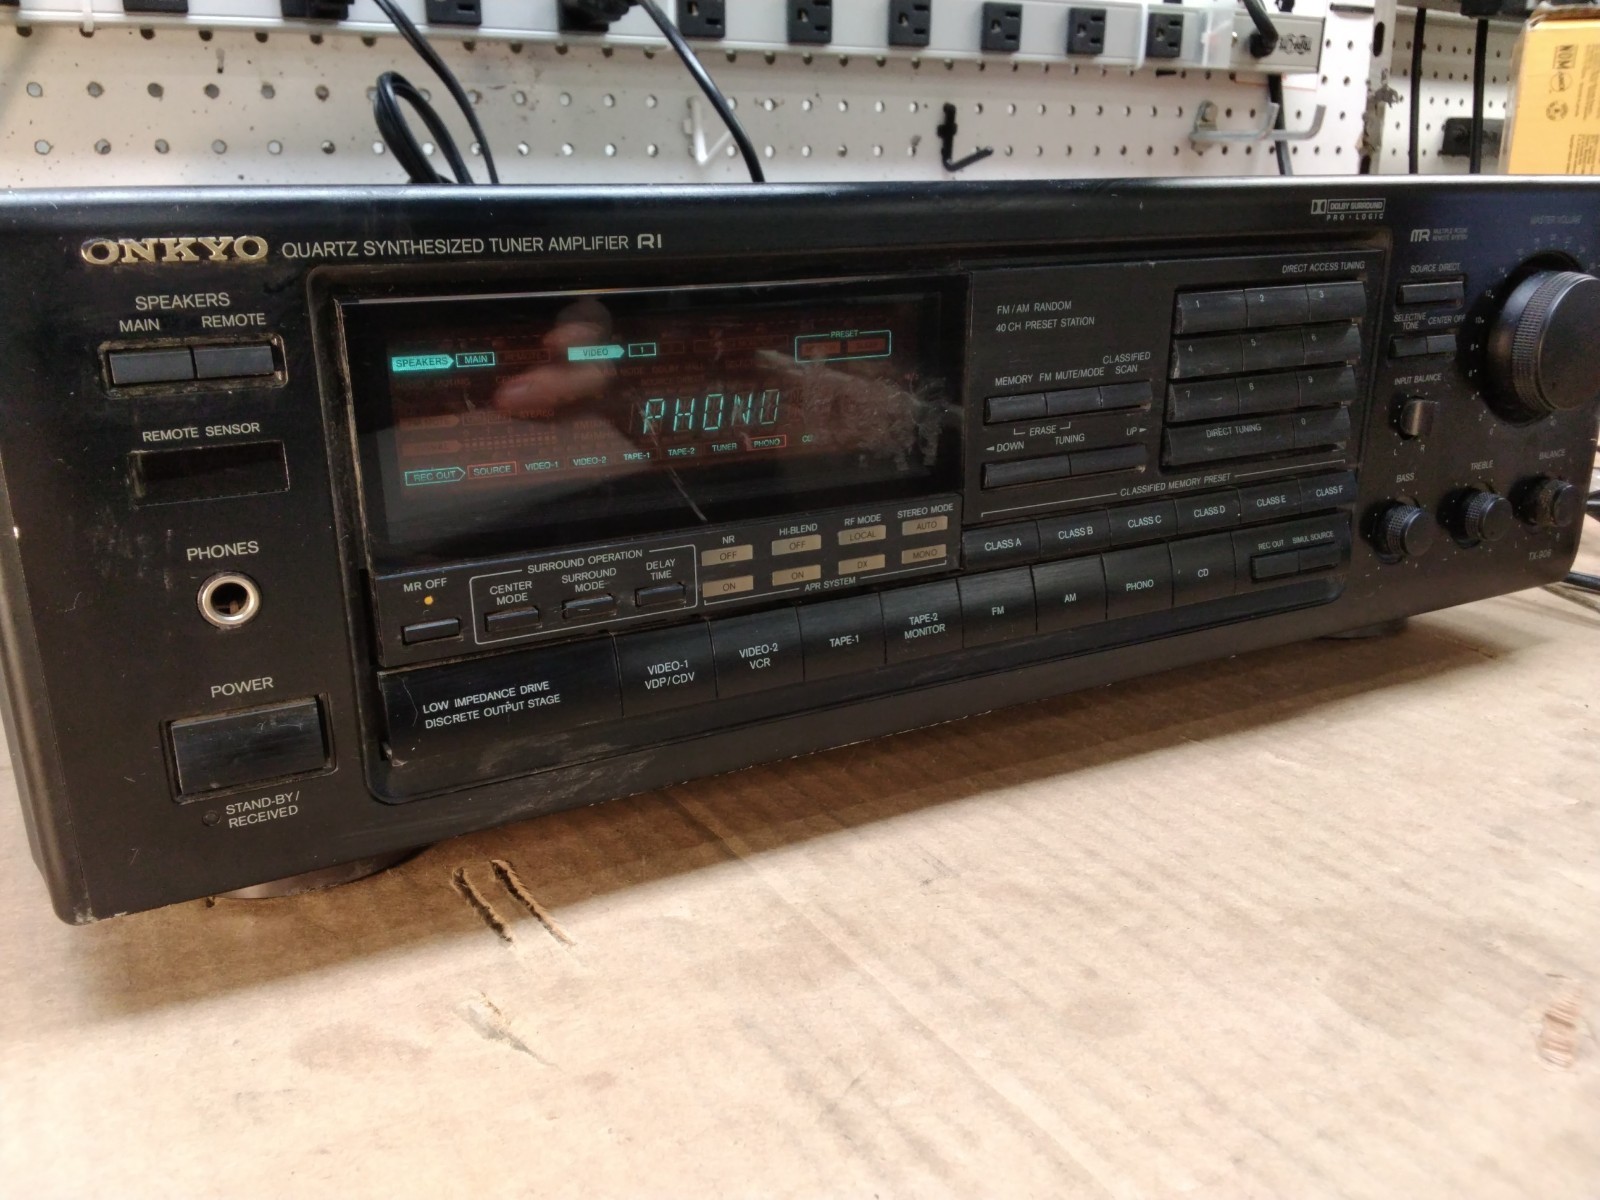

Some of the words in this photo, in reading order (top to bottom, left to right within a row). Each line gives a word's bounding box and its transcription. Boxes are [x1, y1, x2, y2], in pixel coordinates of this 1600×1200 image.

[1351, 201, 1383, 209] SURROUND
[81, 236, 268, 265] ONKYO
[282, 241, 359, 258] QUARTZ
[364, 238, 485, 256] SYNTHESIZED
[489, 237, 544, 254] TUNER
[548, 236, 629, 252] AMPLIFIER
[1282, 264, 1308, 274] DIRECT
[1309, 262, 1338, 272] ACCESS
[1340, 261, 1365, 270] TUNING
[1410, 264, 1437, 274] SOURCE
[1438, 262, 1461, 272] DIRECT
[135, 293, 230, 310] SPEAKERS
[1034, 301, 1072, 312] RANDOM
[119, 319, 160, 333] MAIN
[201, 313, 266, 328] REMOTE
[1394, 312, 1426, 322] SELECTIVE
[1428, 316, 1453, 325] CENTER
[1454, 314, 1466, 322] OFF
[996, 323, 1006, 332] 40
[1008, 322, 1022, 332] CH
[1025, 319, 1058, 330] PRESET
[1060, 316, 1095, 328] STATION
[1402, 322, 1419, 330] TONE
[830, 330, 859, 338] PRESET
[464, 354, 488, 364] MAIN
[582, 348, 608, 358] VIDEO
[1102, 352, 1150, 364] CLASSIFIED
[395, 356, 448, 368] SPEAKERS
[995, 374, 1033, 386] MEMORY
[1039, 372, 1052, 382] FM
[1056, 366, 1105, 380] MUTE/MODE
[1115, 365, 1138, 375] SCAN
[1394, 375, 1413, 385] INPUT
[1414, 372, 1442, 383] BALANCE
[643, 389, 780, 434] PHONO
[142, 428, 200, 442] REMOTE
[205, 422, 260, 436] SENSOR
[1029, 425, 1057, 436] ERASE
[1206, 427, 1232, 438] DIRECT
[1235, 424, 1262, 435] TUNING
[754, 438, 781, 448] PHONO
[996, 442, 1024, 452] DOWN
[1055, 433, 1086, 445] TUNING
[1126, 427, 1138, 436] UP
[668, 447, 695, 457] TAPE-2
[712, 442, 738, 452] TUNER
[573, 456, 607, 467] VIDEO-2
[624, 452, 651, 462] TAPE-1
[473, 464, 511, 476] SOURCE
[525, 460, 559, 472] VIDEO-1
[1471, 460, 1494, 470] TREBLE
[414, 472, 436, 482] REC
[437, 470, 456, 480] OUT
[1396, 472, 1414, 484] BASS
[1120, 482, 1166, 497] CLASSIFIED
[1168, 477, 1200, 492] MEMORY
[1203, 473, 1232, 486] PRESET
[1316, 488, 1336, 498] CLASS
[1337, 486, 1344, 494] F
[1256, 496, 1278, 508] CLASS
[1279, 494, 1286, 504] E
[897, 506, 928, 518] STEREO
[930, 503, 954, 514] MODE
[1194, 507, 1217, 518] CLASS
[1218, 505, 1226, 514] D
[844, 517, 858, 526] RF
[858, 514, 882, 525] MODE
[916, 520, 938, 530] AUTO
[1128, 517, 1152, 529] CLASS
[1154, 516, 1162, 525] C
[779, 524, 818, 536] HI-BLEND
[1058, 528, 1084, 540] CLASS
[1086, 526, 1094, 536] B
[1311, 530, 1334, 542] SOURCE
[722, 536, 736, 544] NR
[789, 540, 806, 550] OFF
[984, 540, 1012, 552] CLASS
[1013, 538, 1022, 548] A
[1258, 541, 1271, 551] REC
[1272, 539, 1284, 549] OUT
[186, 541, 260, 561] PHONES
[720, 551, 738, 561] OFF
[912, 548, 938, 559] MONO
[528, 558, 585, 574] SURROUND
[588, 550, 643, 565] OPERATION
[646, 559, 676, 571] DELAY
[857, 560, 868, 570] DX
[561, 568, 616, 584] SURROUND
[650, 570, 672, 580] TIME
[791, 570, 805, 580] ON
[1198, 568, 1209, 578] CD
[404, 581, 422, 592] MR
[425, 578, 448, 589] OFF
[489, 580, 532, 595] CENTER
[574, 581, 604, 593] MODE
[722, 582, 736, 591] ON
[804, 581, 822, 592] APR
[824, 576, 856, 589] SYSTEM
[1126, 578, 1154, 592] PHONO
[496, 592, 528, 606] MODE
[1064, 594, 1077, 604] AM
[992, 606, 1005, 616] FM
[909, 612, 939, 626] TAPE-2
[904, 624, 946, 640] MONITOR
[829, 634, 860, 648] TAPE-1
[739, 642, 779, 659] VIDEO-2
[647, 660, 689, 676] VIDEO-1
[750, 657, 771, 670] VCR
[645, 672, 696, 690] VDP/CDV
[210, 677, 274, 698] POWER
[422, 700, 449, 714] LOW
[454, 688, 517, 708] IMPEDANCE
[520, 681, 550, 696] DRIVE
[425, 710, 480, 729] DISCRETE
[484, 702, 525, 718] OUTPUT
[528, 694, 561, 708] STAGE
[229, 804, 299, 829] RECEIVED
